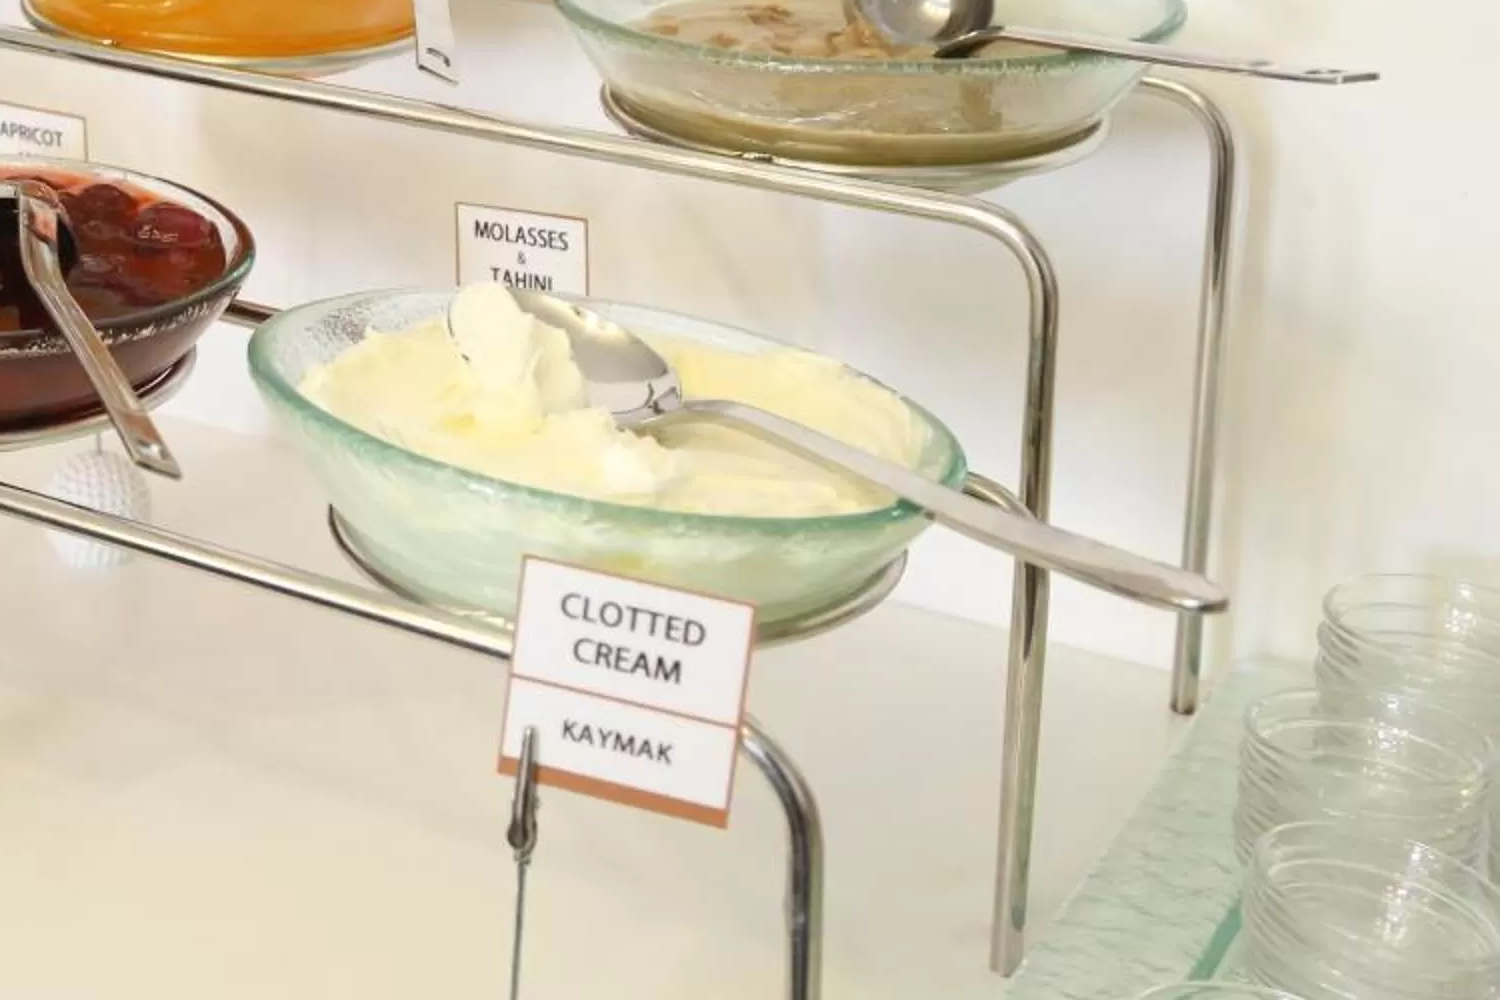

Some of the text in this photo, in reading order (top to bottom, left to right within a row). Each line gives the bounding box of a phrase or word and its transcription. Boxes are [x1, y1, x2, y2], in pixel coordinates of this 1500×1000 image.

[0, 120, 63, 148] APRICOT
[474, 219, 569, 251] MOLASSES
[517, 250, 527, 265] &
[491, 267, 553, 291] TAHINI
[560, 593, 706, 647] CLOTTED
[573, 637, 682, 684] CREAM
[562, 719, 673, 766] KAYMAK
